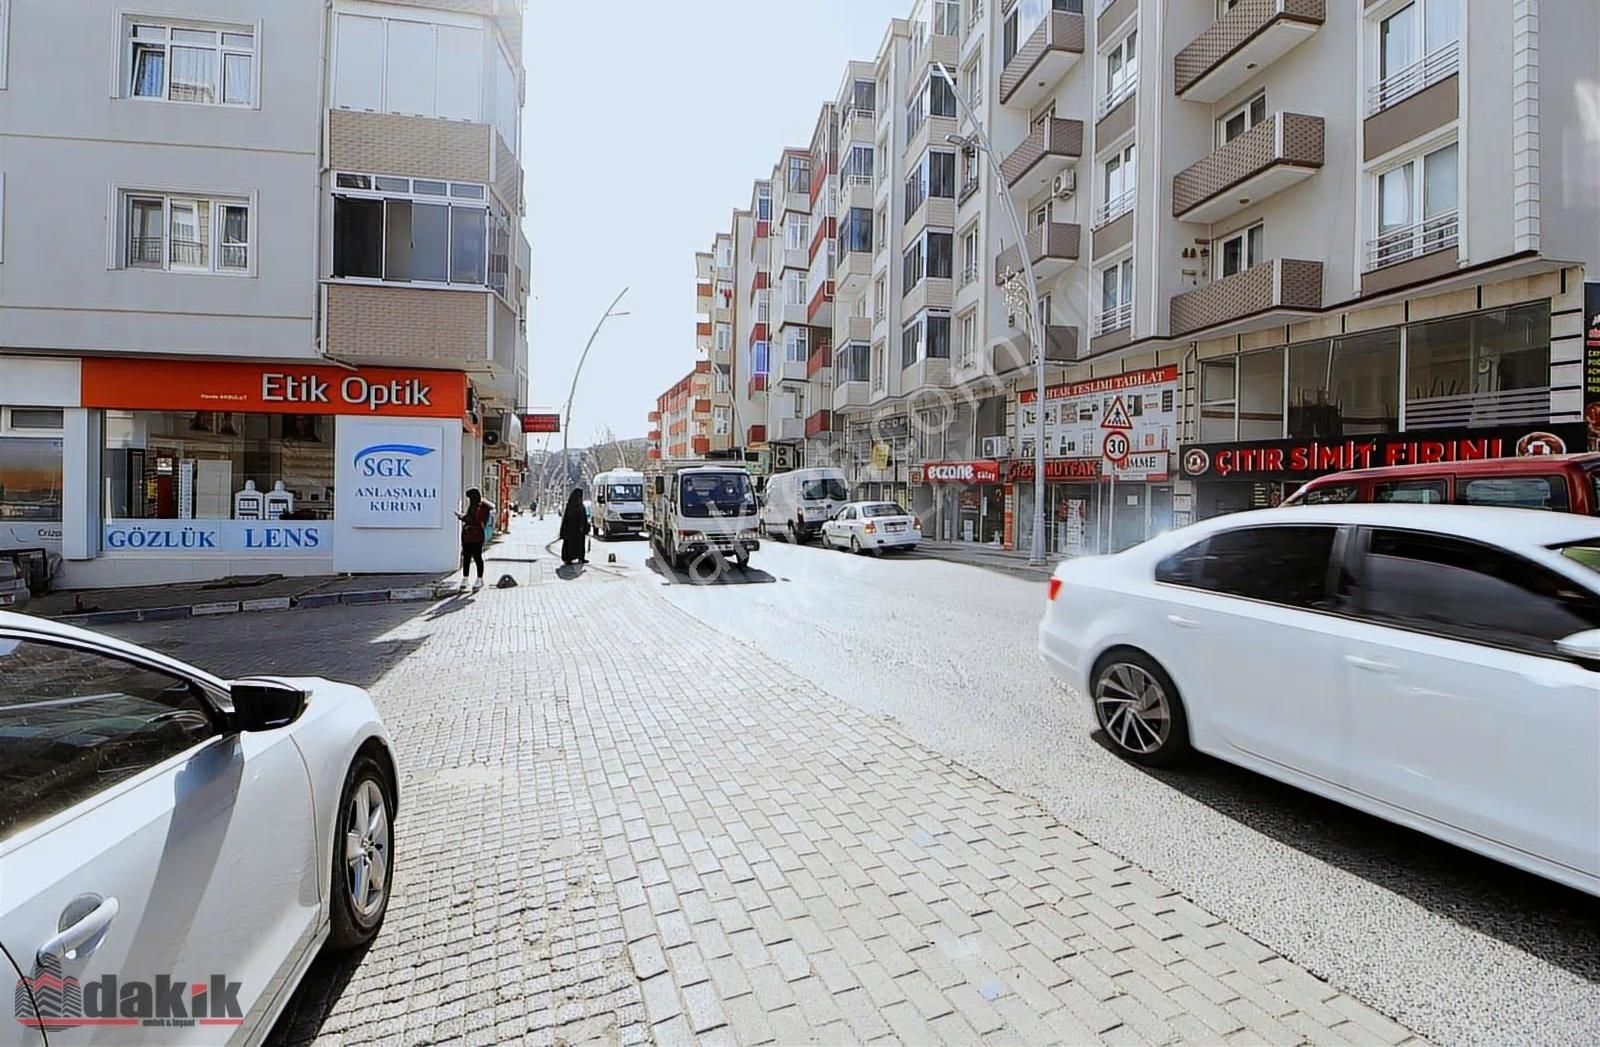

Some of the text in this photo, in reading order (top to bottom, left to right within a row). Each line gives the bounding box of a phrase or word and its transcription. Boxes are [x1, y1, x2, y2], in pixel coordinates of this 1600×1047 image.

[262, 373, 431, 410] Etik Optik
[1109, 439, 1125, 454] 30
[1215, 438, 1503, 476] ÇITIR SİMİT FIRINI
[363, 458, 413, 477] SGK
[928, 464, 975, 479] eczane
[355, 487, 436, 500] ANLAŞMALI
[370, 501, 422, 512] KURUM
[108, 526, 319, 548] GÖZLÜK LENS
